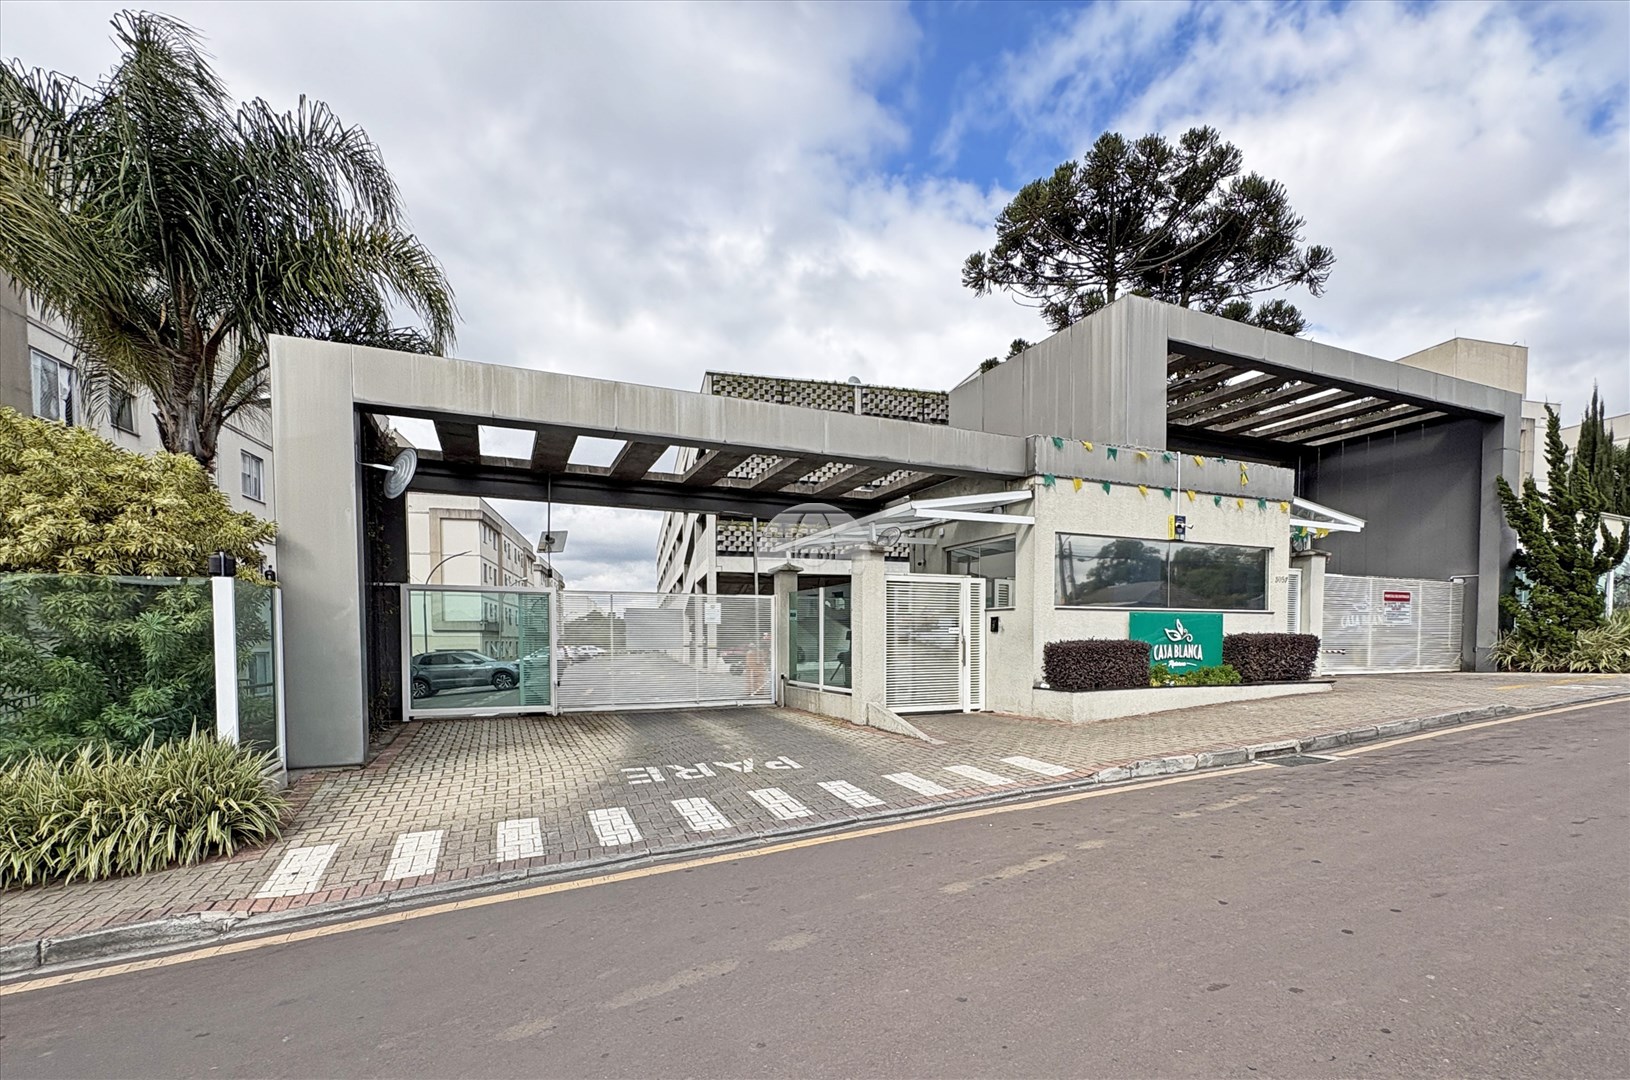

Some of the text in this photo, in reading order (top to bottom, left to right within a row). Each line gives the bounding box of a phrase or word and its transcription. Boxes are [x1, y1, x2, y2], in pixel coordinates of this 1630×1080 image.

[1153, 644, 1203, 660] CASA BLANCA
[620, 755, 804, 785] PARE
